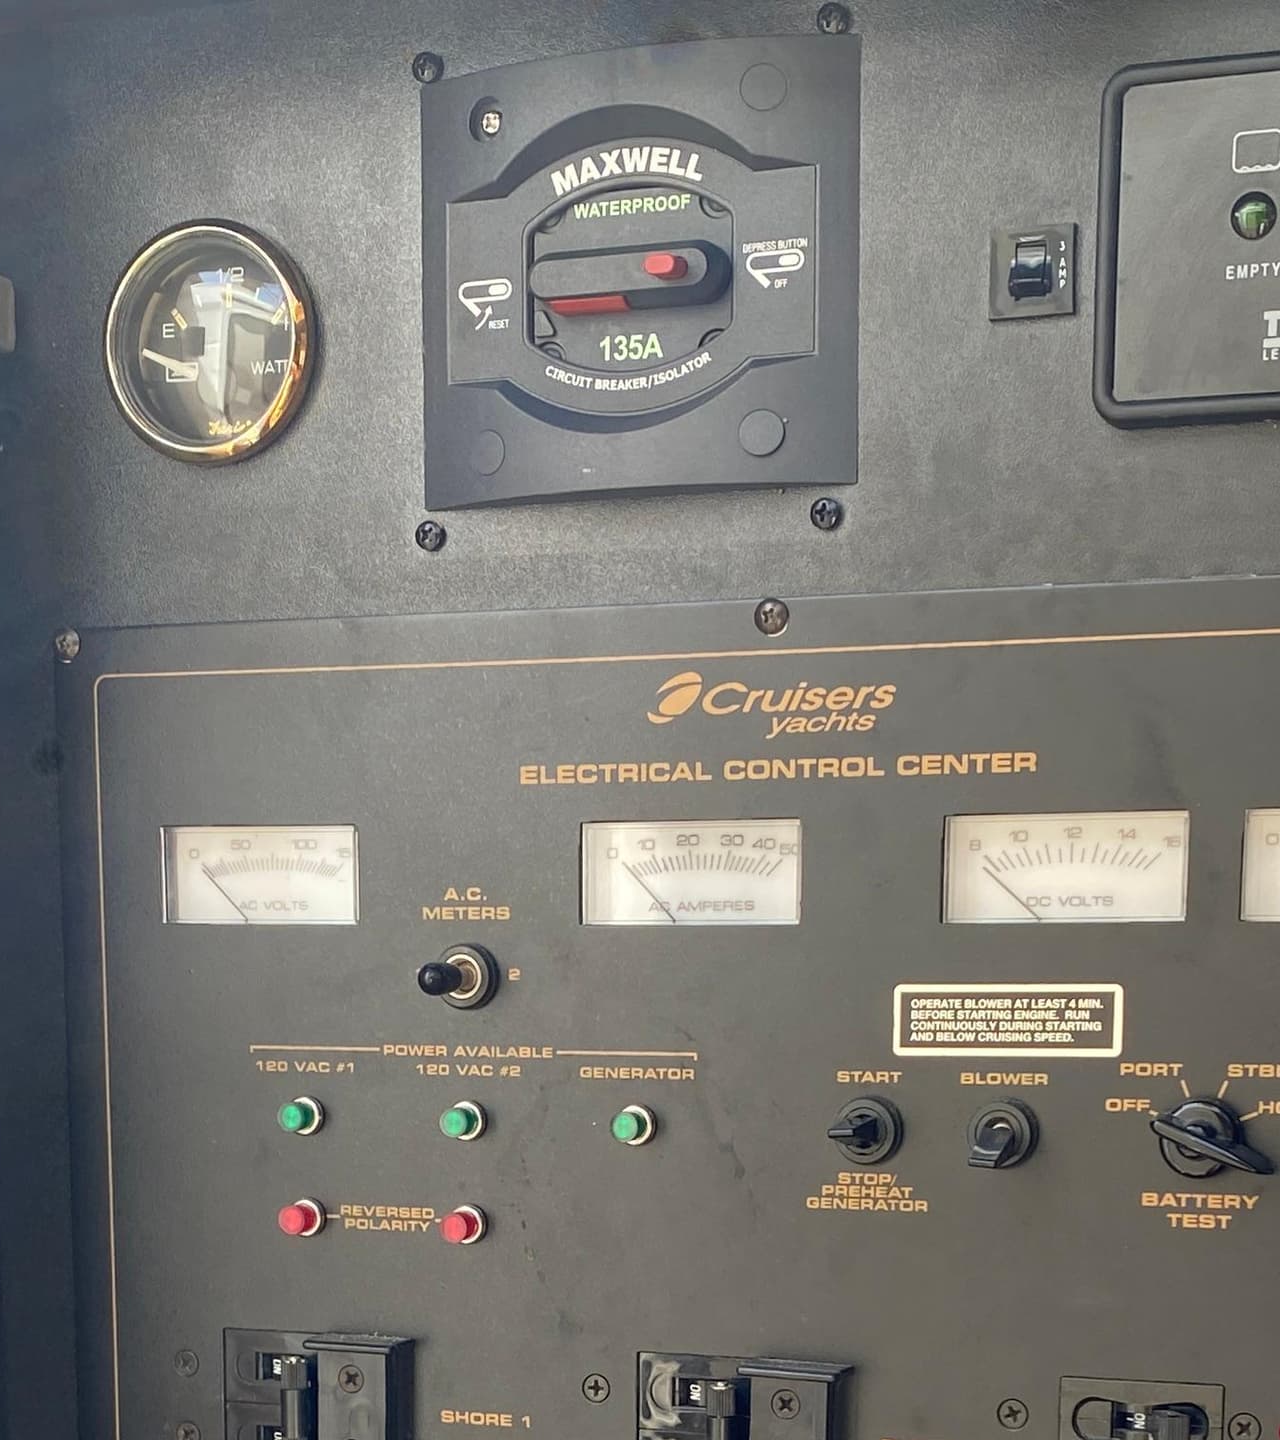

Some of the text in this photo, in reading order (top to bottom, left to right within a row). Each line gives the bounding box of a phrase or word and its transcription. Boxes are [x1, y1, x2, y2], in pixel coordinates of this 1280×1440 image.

[551, 146, 702, 197] MAXWELL
[574, 194, 690, 219] WATERPROOF
[779, 237, 808, 249] BUTTON
[1226, 262, 1280, 279] EMPTY
[775, 279, 787, 288] OFF
[163, 323, 174, 338] E
[489, 319, 509, 329] RESET
[600, 334, 663, 361] 135A
[546, 352, 711, 390] CIRCUIT BREAKER/ISOLATOR
[702, 679, 896, 716] Cruisers
[766, 712, 876, 739] yachts
[520, 753, 1036, 784] ELECTRICAL CONTROL CENTER
[1265, 833, 1279, 845] 0
[444, 888, 486, 900] A.C.
[240, 901, 308, 911] AC VOLTS
[649, 900, 754, 912] AC AMPERES
[1026, 895, 1113, 907] DC VOLTS
[423, 907, 510, 919] METERS
[509, 969, 520, 980] 2
[911, 999, 1103, 1008] OPERATE BLOWER AT LEAST 4 MIN.
[911, 1010, 1089, 1019] BEFORE STARTING ENGINE. RUN
[911, 1021, 1101, 1031] CONTINUOUSLY DURING STARTING
[910, 1032, 1074, 1042] AND BELOW CRUISING SPEED.
[384, 1045, 552, 1058] POWER AVAILABLE
[256, 1061, 353, 1072] 120 VAC #1
[416, 1064, 520, 1076] 120 VAC #2
[580, 1067, 694, 1079] GENERATOR
[1120, 1063, 1183, 1076] PORT
[837, 1071, 902, 1083] START
[961, 1072, 1048, 1085] BLOWER
[1106, 1099, 1150, 1111] OFF
[838, 1173, 896, 1186] STOP/
[822, 1185, 913, 1198] PREHEAT
[807, 1197, 927, 1212] GENERATOR
[1142, 1193, 1258, 1209] BATTERY
[341, 1205, 434, 1219] REVERSED
[345, 1218, 430, 1232] POLARITY
[1167, 1214, 1232, 1228] TEST
[441, 1410, 530, 1428] SHORE 1
